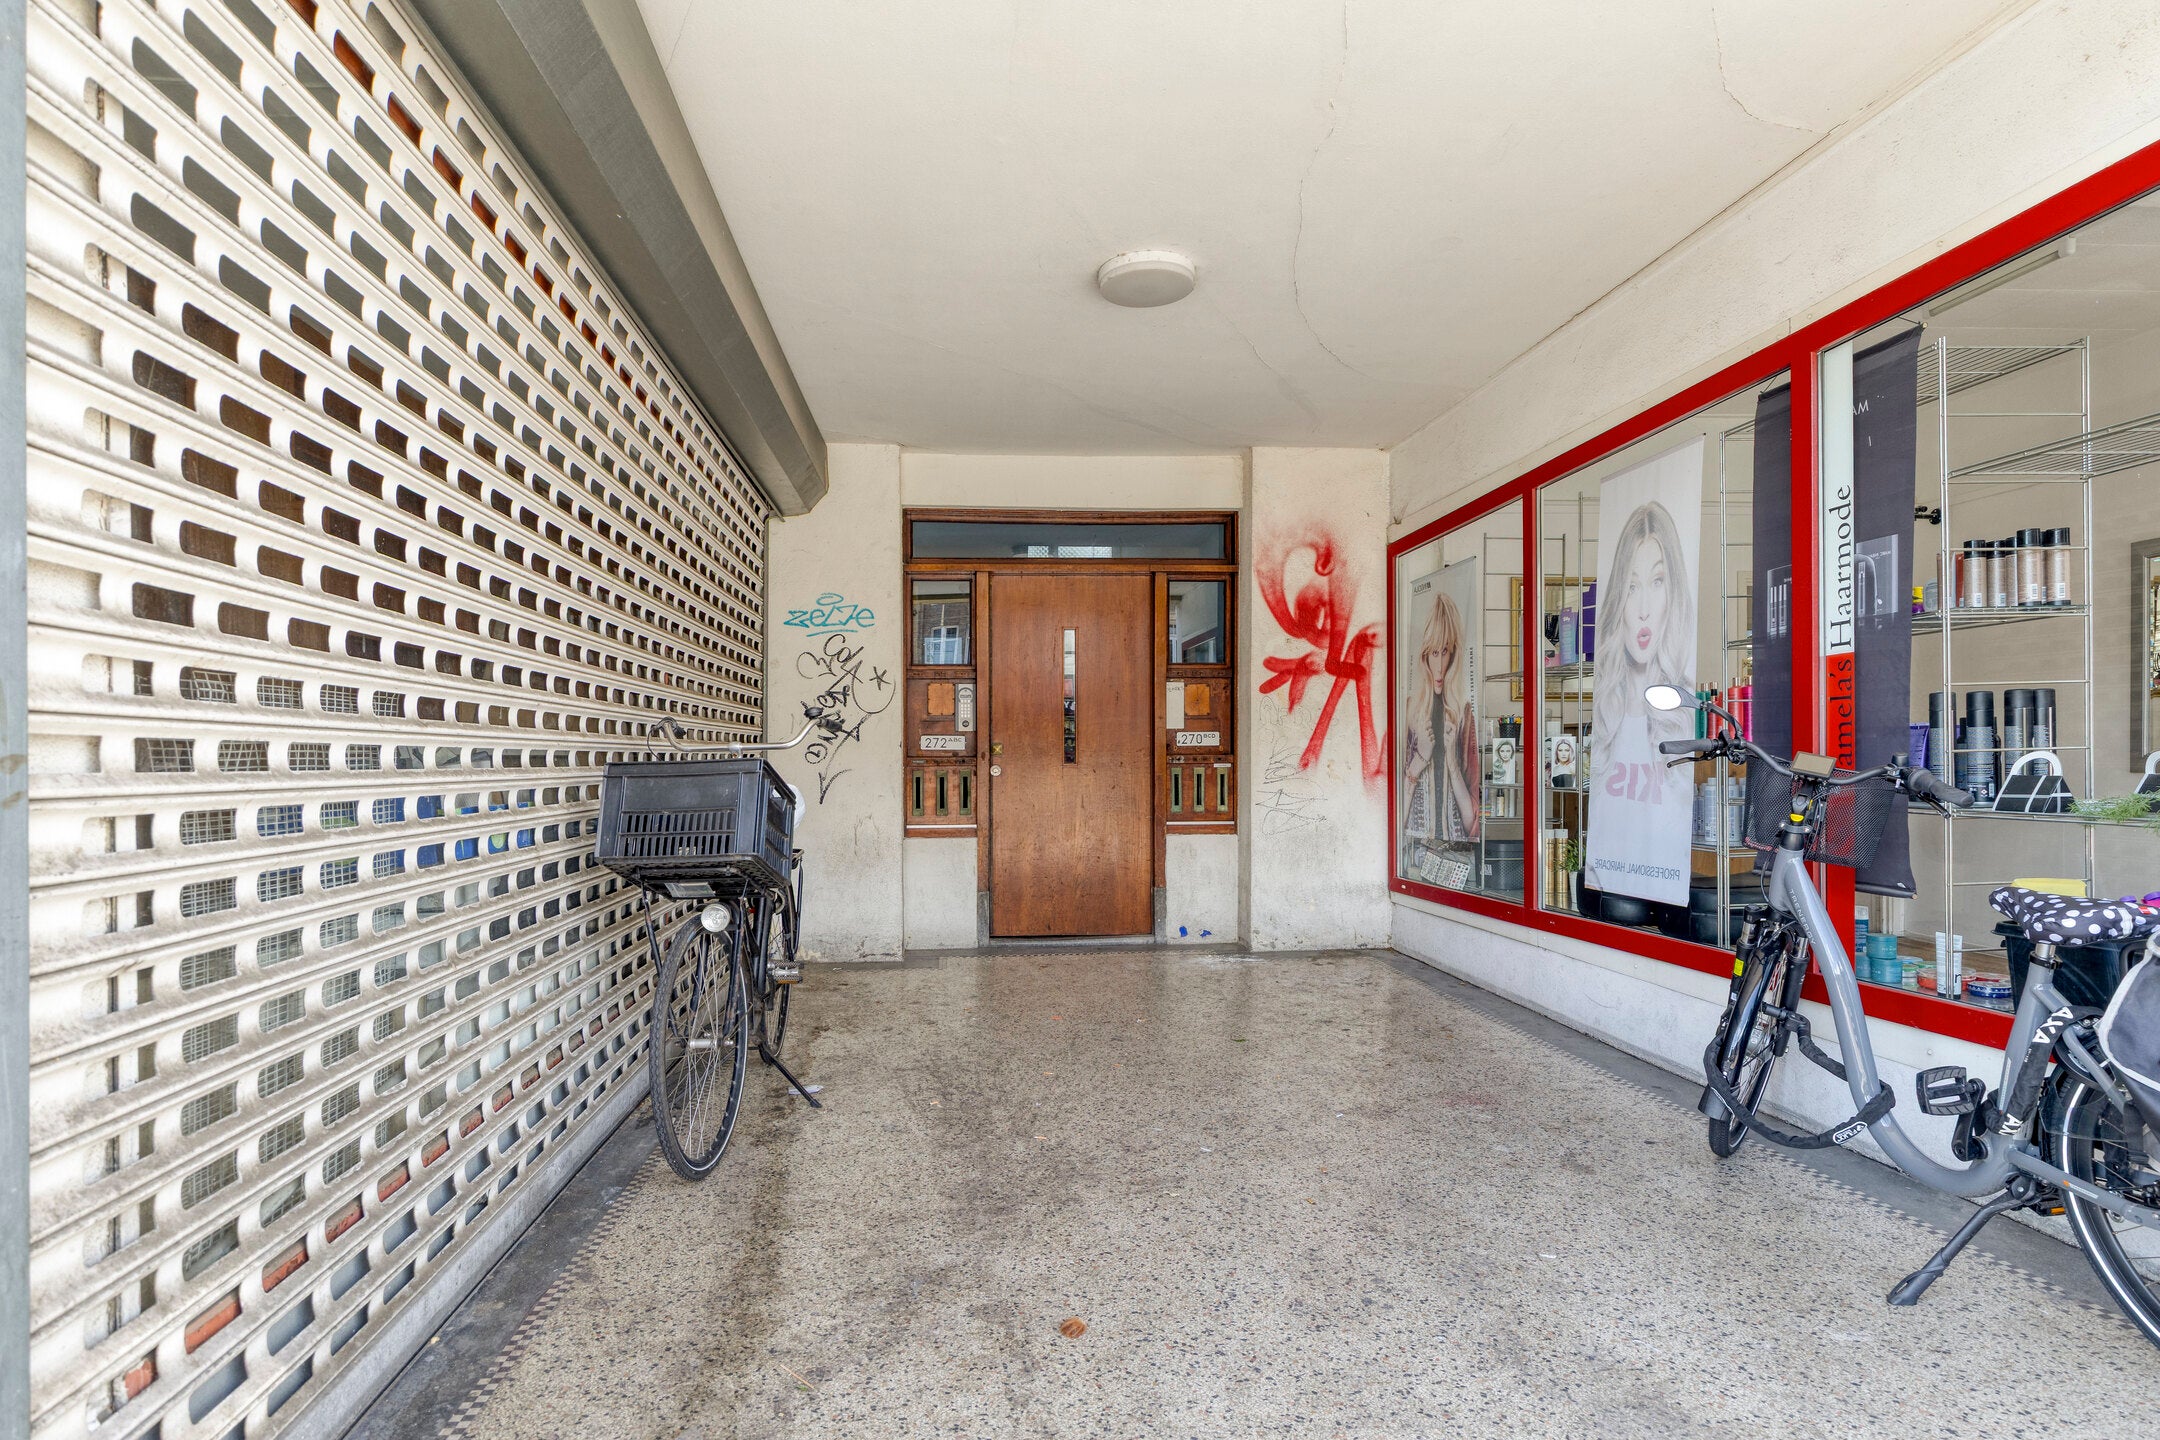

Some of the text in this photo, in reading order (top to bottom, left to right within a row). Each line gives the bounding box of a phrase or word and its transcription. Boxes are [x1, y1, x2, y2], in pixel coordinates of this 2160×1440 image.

[1829, 484, 1853, 767] amela's Haarmode
[2032, 1006, 2074, 1044] AXA
